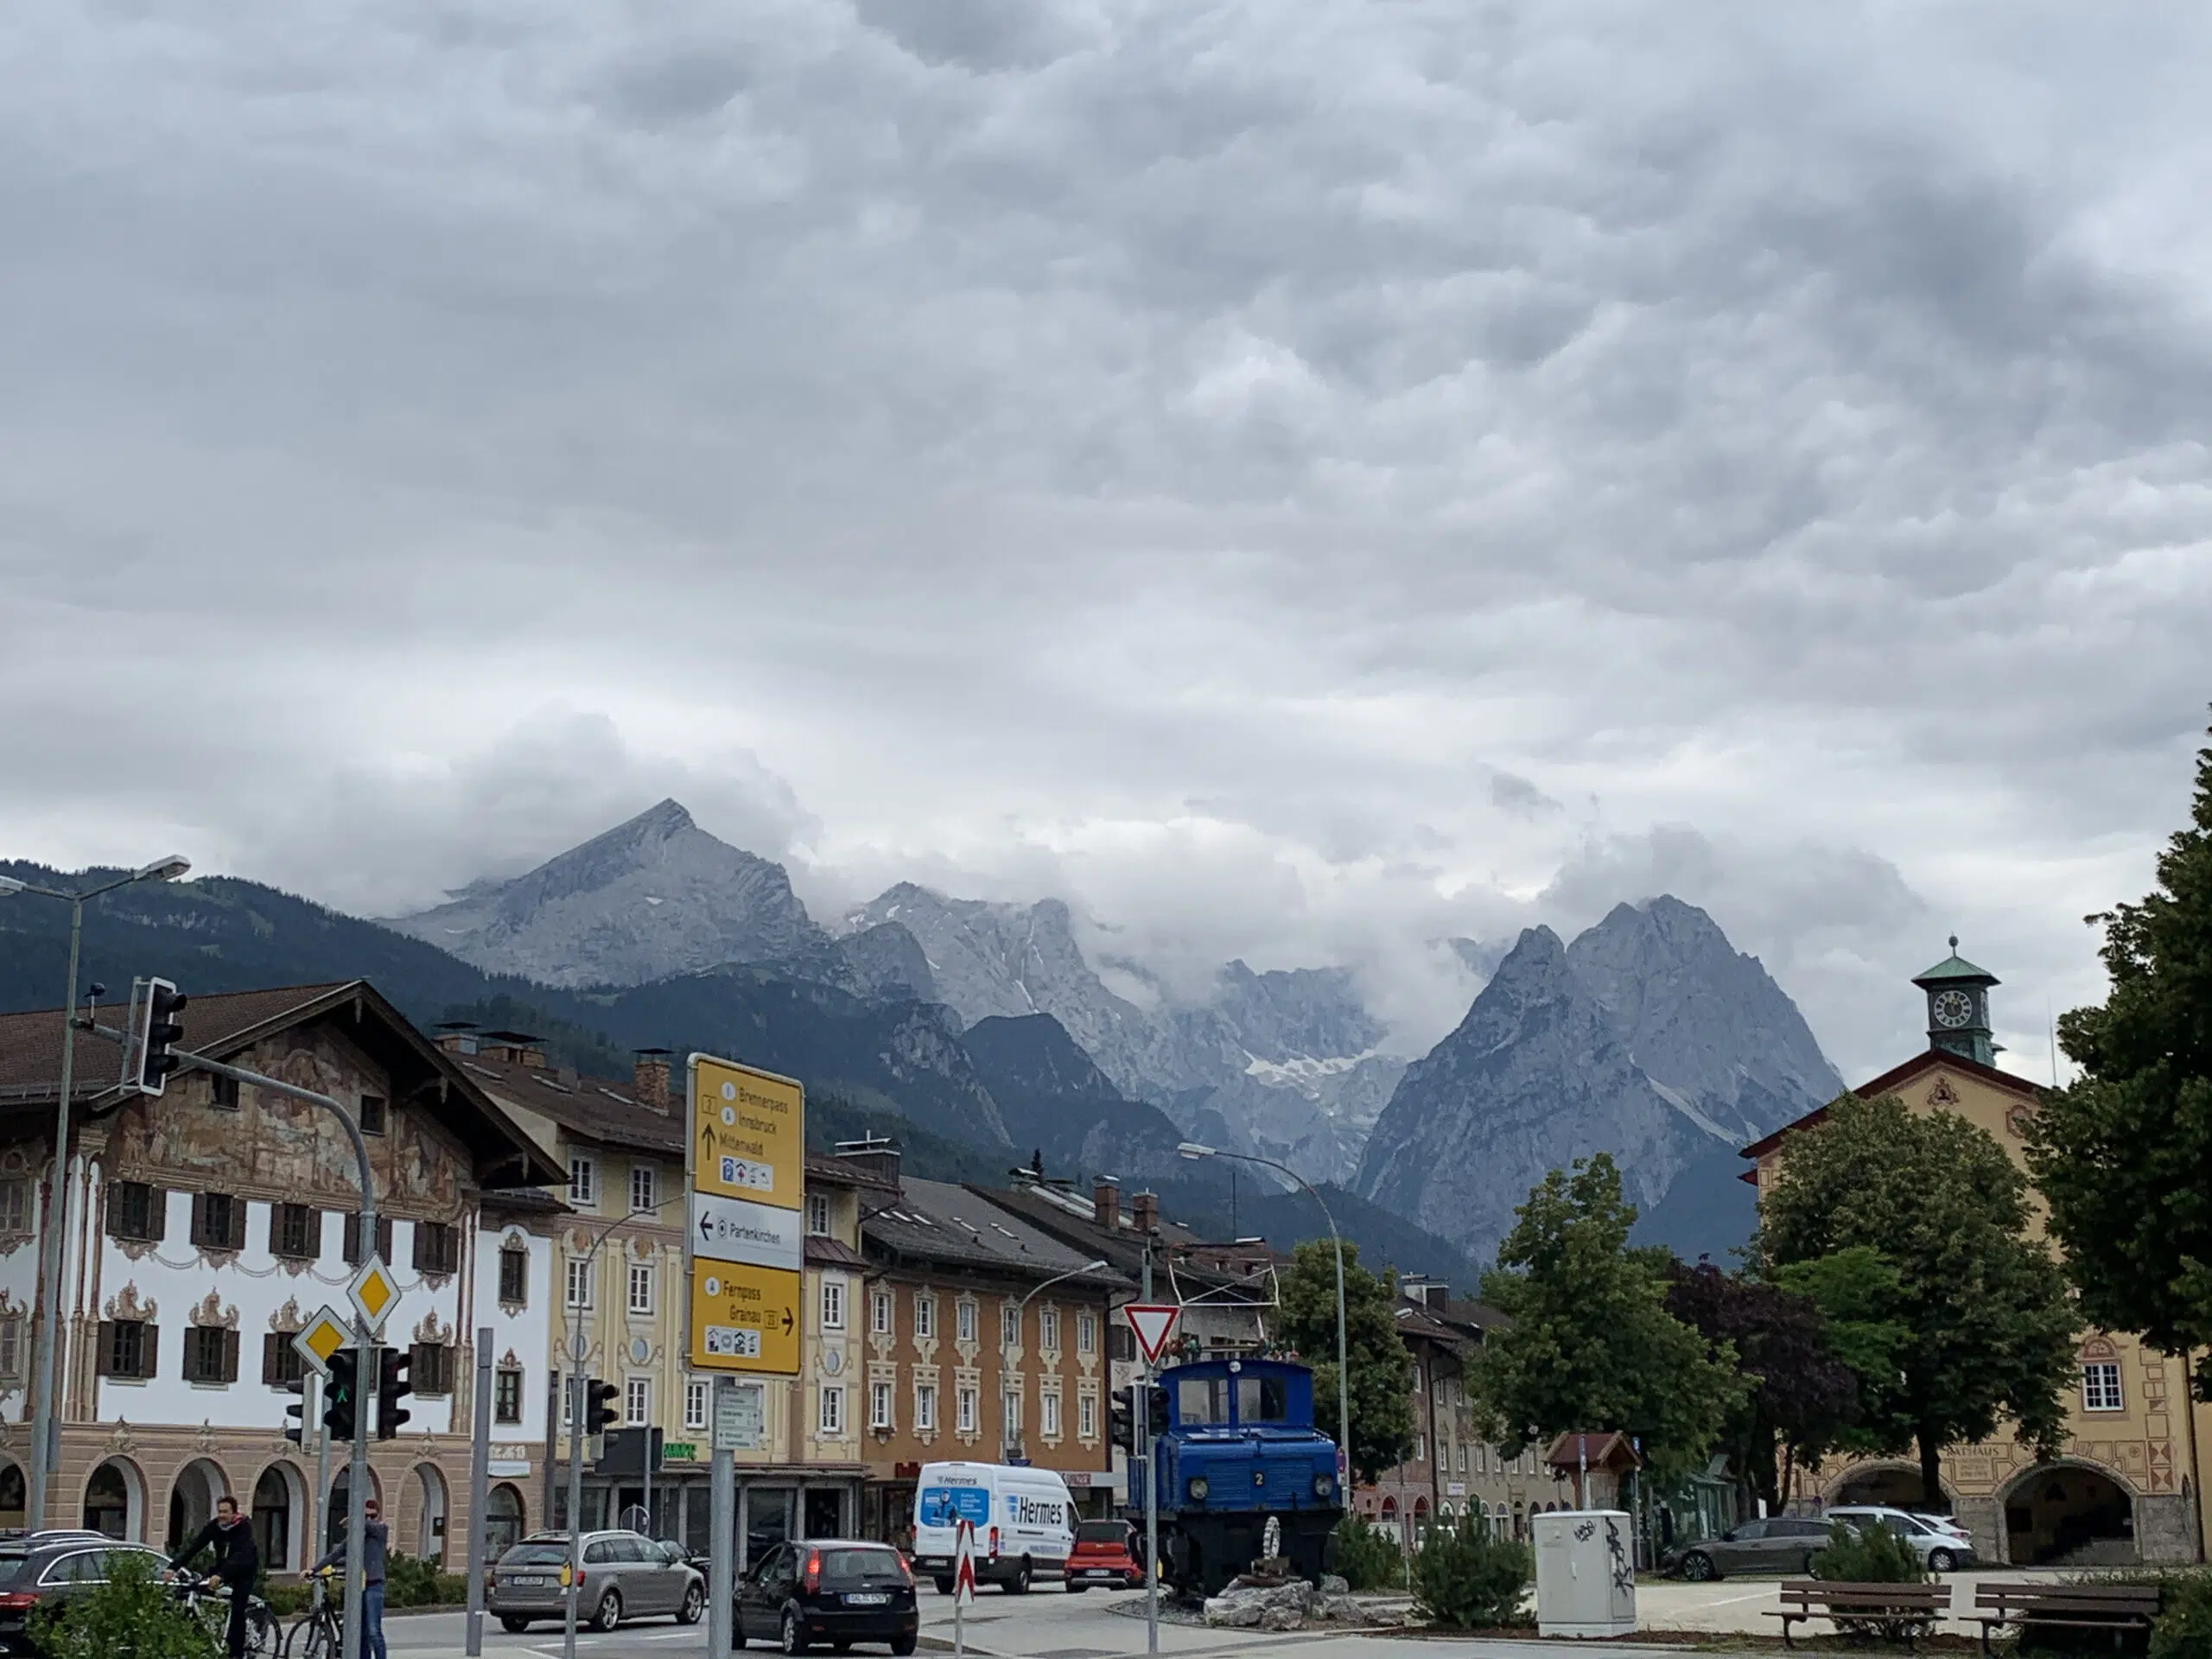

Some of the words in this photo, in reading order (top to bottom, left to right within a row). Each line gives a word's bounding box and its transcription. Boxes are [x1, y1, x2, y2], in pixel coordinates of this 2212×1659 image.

[739, 1086, 788, 1115] Brennerpass
[739, 1110, 777, 1135] Innsbruck
[719, 1131, 763, 1156] Mittenwald
[730, 1223, 780, 1244] Partenkirchen
[723, 1280, 761, 1302] Fernpass
[729, 1304, 761, 1323] Grainau
[944, 1477, 977, 1485] Hermes
[1254, 1472, 1263, 1485] 2
[1018, 1497, 1063, 1524] Hermes
